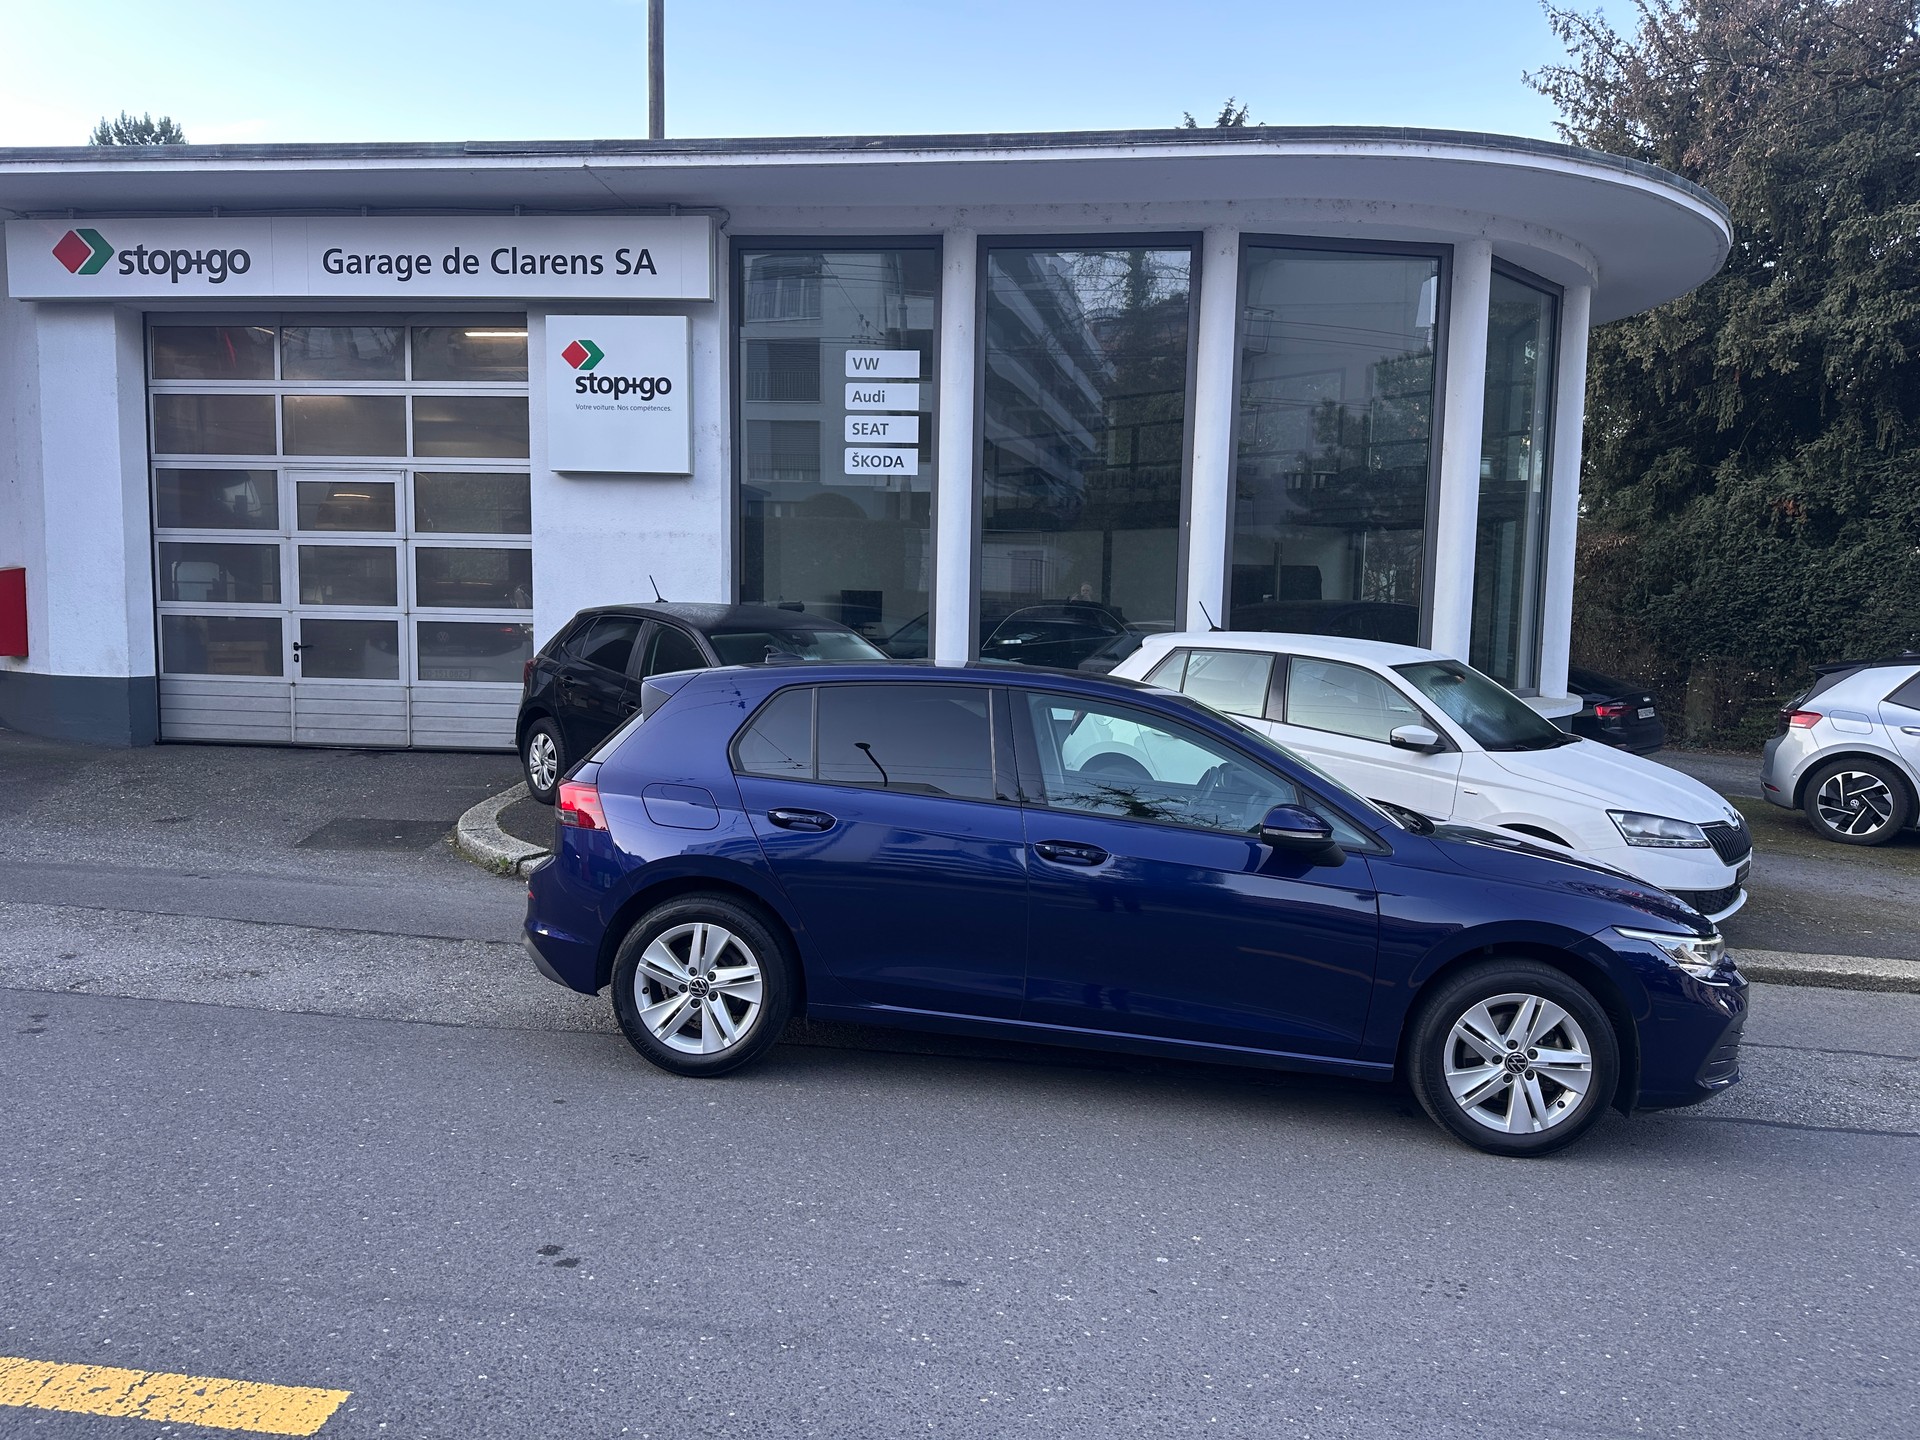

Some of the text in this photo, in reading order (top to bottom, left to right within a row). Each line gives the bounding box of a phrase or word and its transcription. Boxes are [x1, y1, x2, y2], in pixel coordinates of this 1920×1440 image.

[118, 244, 251, 283] stop+go
[322, 247, 657, 282] Garage de Clarens SA
[852, 357, 880, 370] VW
[575, 372, 672, 401] stop+go
[852, 390, 885, 403] Audi
[852, 422, 889, 436] SEAT
[852, 452, 904, 468] ŠKODA
